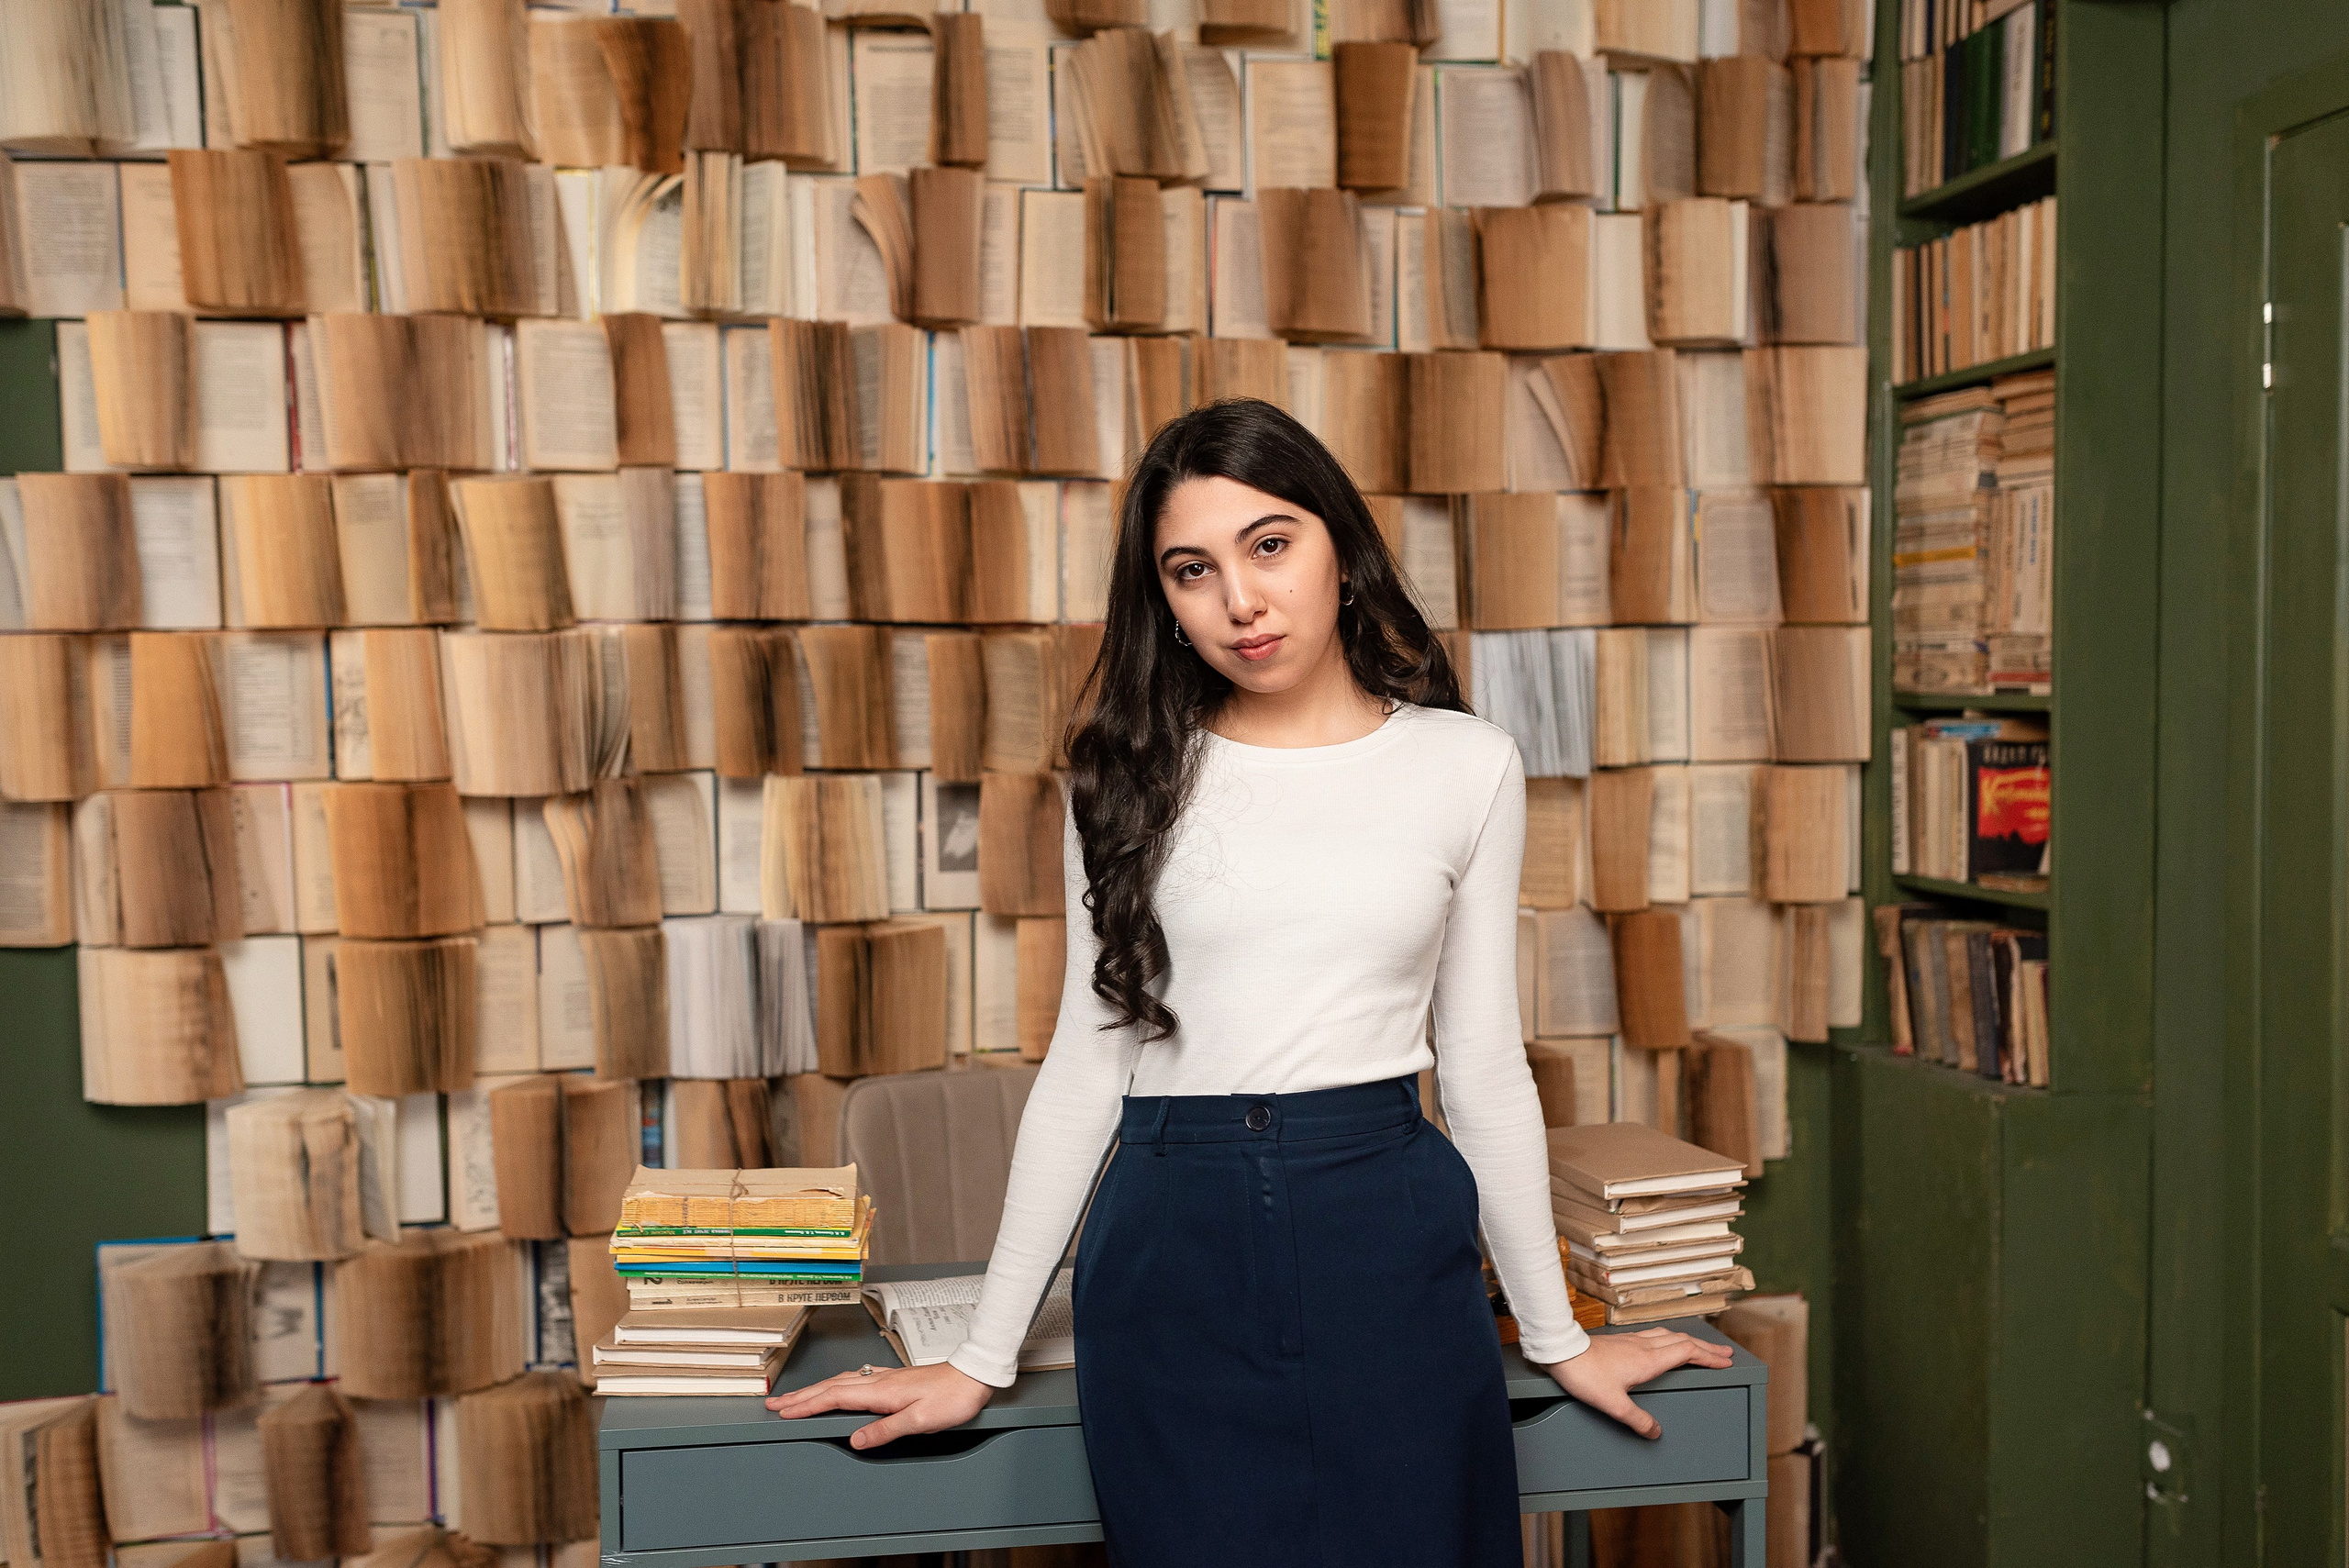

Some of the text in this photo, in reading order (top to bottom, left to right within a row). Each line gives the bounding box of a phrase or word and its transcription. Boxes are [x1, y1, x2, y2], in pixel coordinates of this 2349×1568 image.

[778, 1292, 852, 1303] В КРУГЕ ПЕРВОМ
